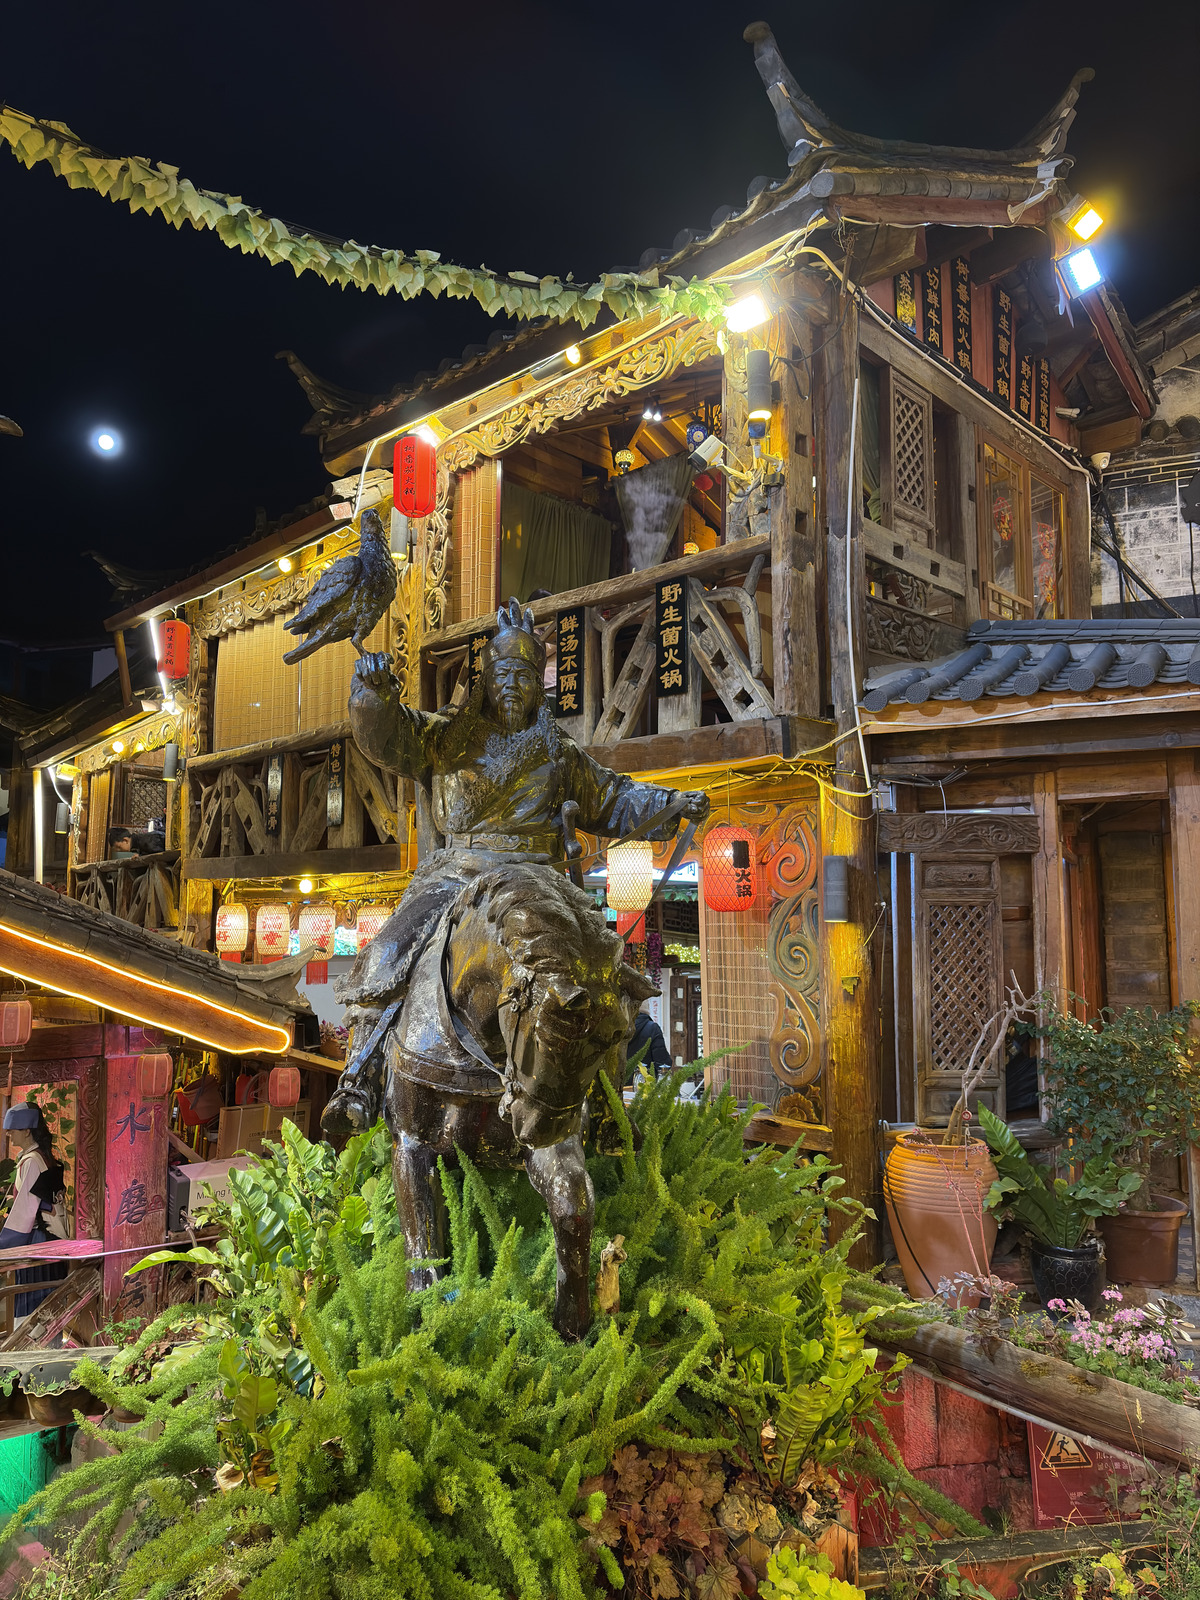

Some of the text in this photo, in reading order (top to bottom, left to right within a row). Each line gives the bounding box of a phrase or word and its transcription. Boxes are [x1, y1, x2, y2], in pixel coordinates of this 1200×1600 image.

[926, 267, 941, 348] 切鲜牛肉
[955, 258, 971, 373] 树番茄火锅
[996, 291, 1011, 400] 野生菌火锅
[1018, 355, 1032, 414] 野生菌
[1038, 358, 1049, 432] 鲜汤不隔夜
[558, 615, 579, 711] 鲜汤不隔夜
[660, 583, 683, 690] 野生菌火锅
[735, 869, 752, 898] 火锅
[111, 1102, 152, 1313] 水磨房
